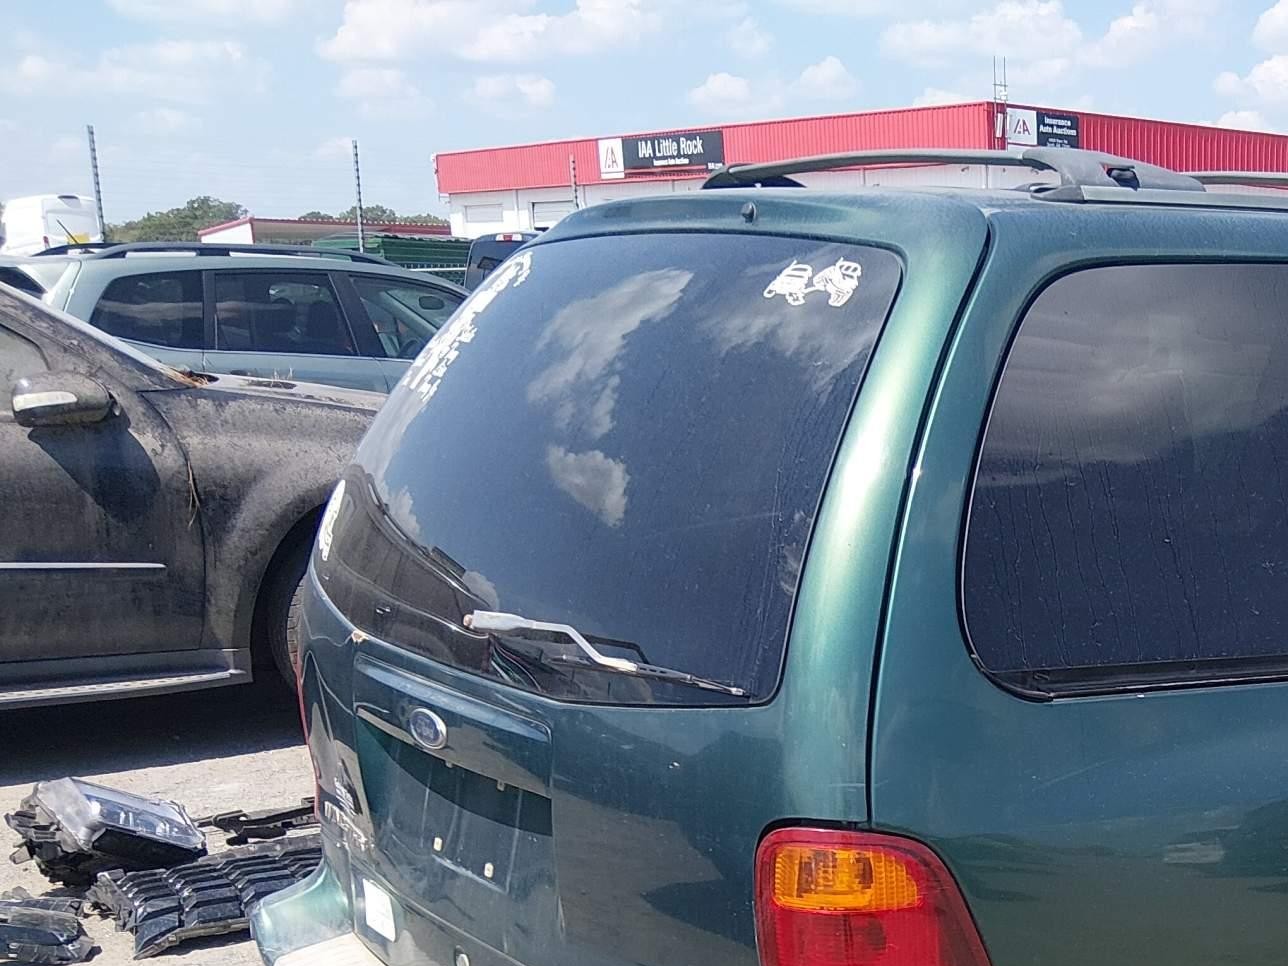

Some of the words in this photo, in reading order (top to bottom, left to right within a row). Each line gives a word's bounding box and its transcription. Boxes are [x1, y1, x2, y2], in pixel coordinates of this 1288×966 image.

[638, 140, 653, 158] IAA
[655, 138, 678, 157] Little
[680, 136, 704, 154] Rock
